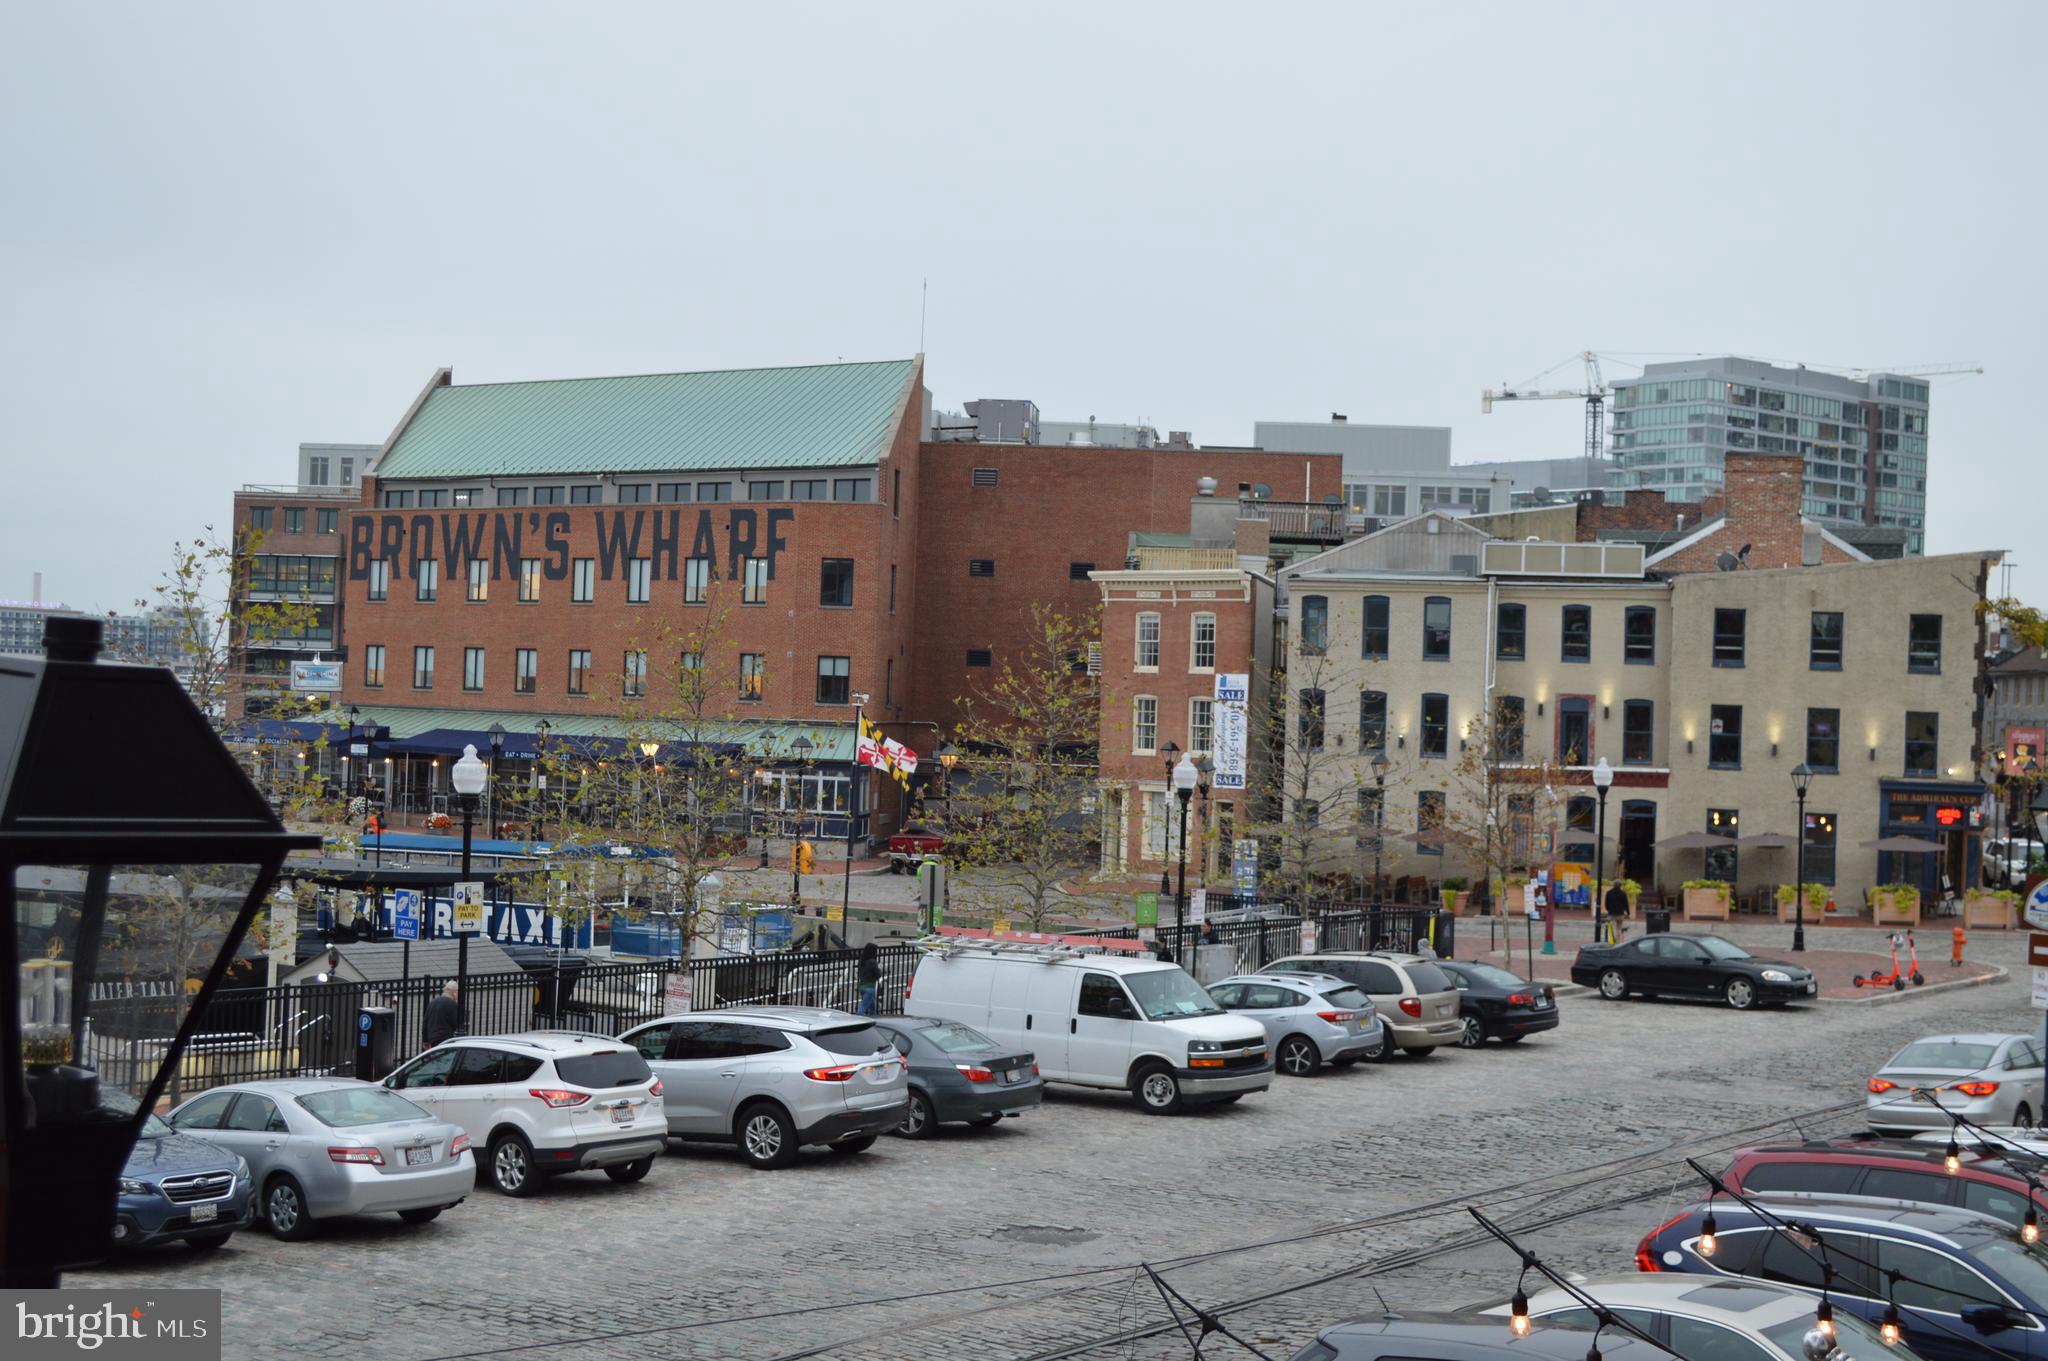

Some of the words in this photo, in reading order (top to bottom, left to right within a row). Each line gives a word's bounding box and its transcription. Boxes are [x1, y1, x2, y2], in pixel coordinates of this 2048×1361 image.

[350, 511, 571, 580] BROWN'S
[594, 508, 795, 581] WHARF
[1219, 690, 1244, 700] SALE
[1216, 775, 1242, 785] SALE
[400, 920, 413, 928] PAY
[480, 904, 563, 944] TAXI
[398, 929, 416, 937] HERE
[141, 981, 175, 997] TAXI
